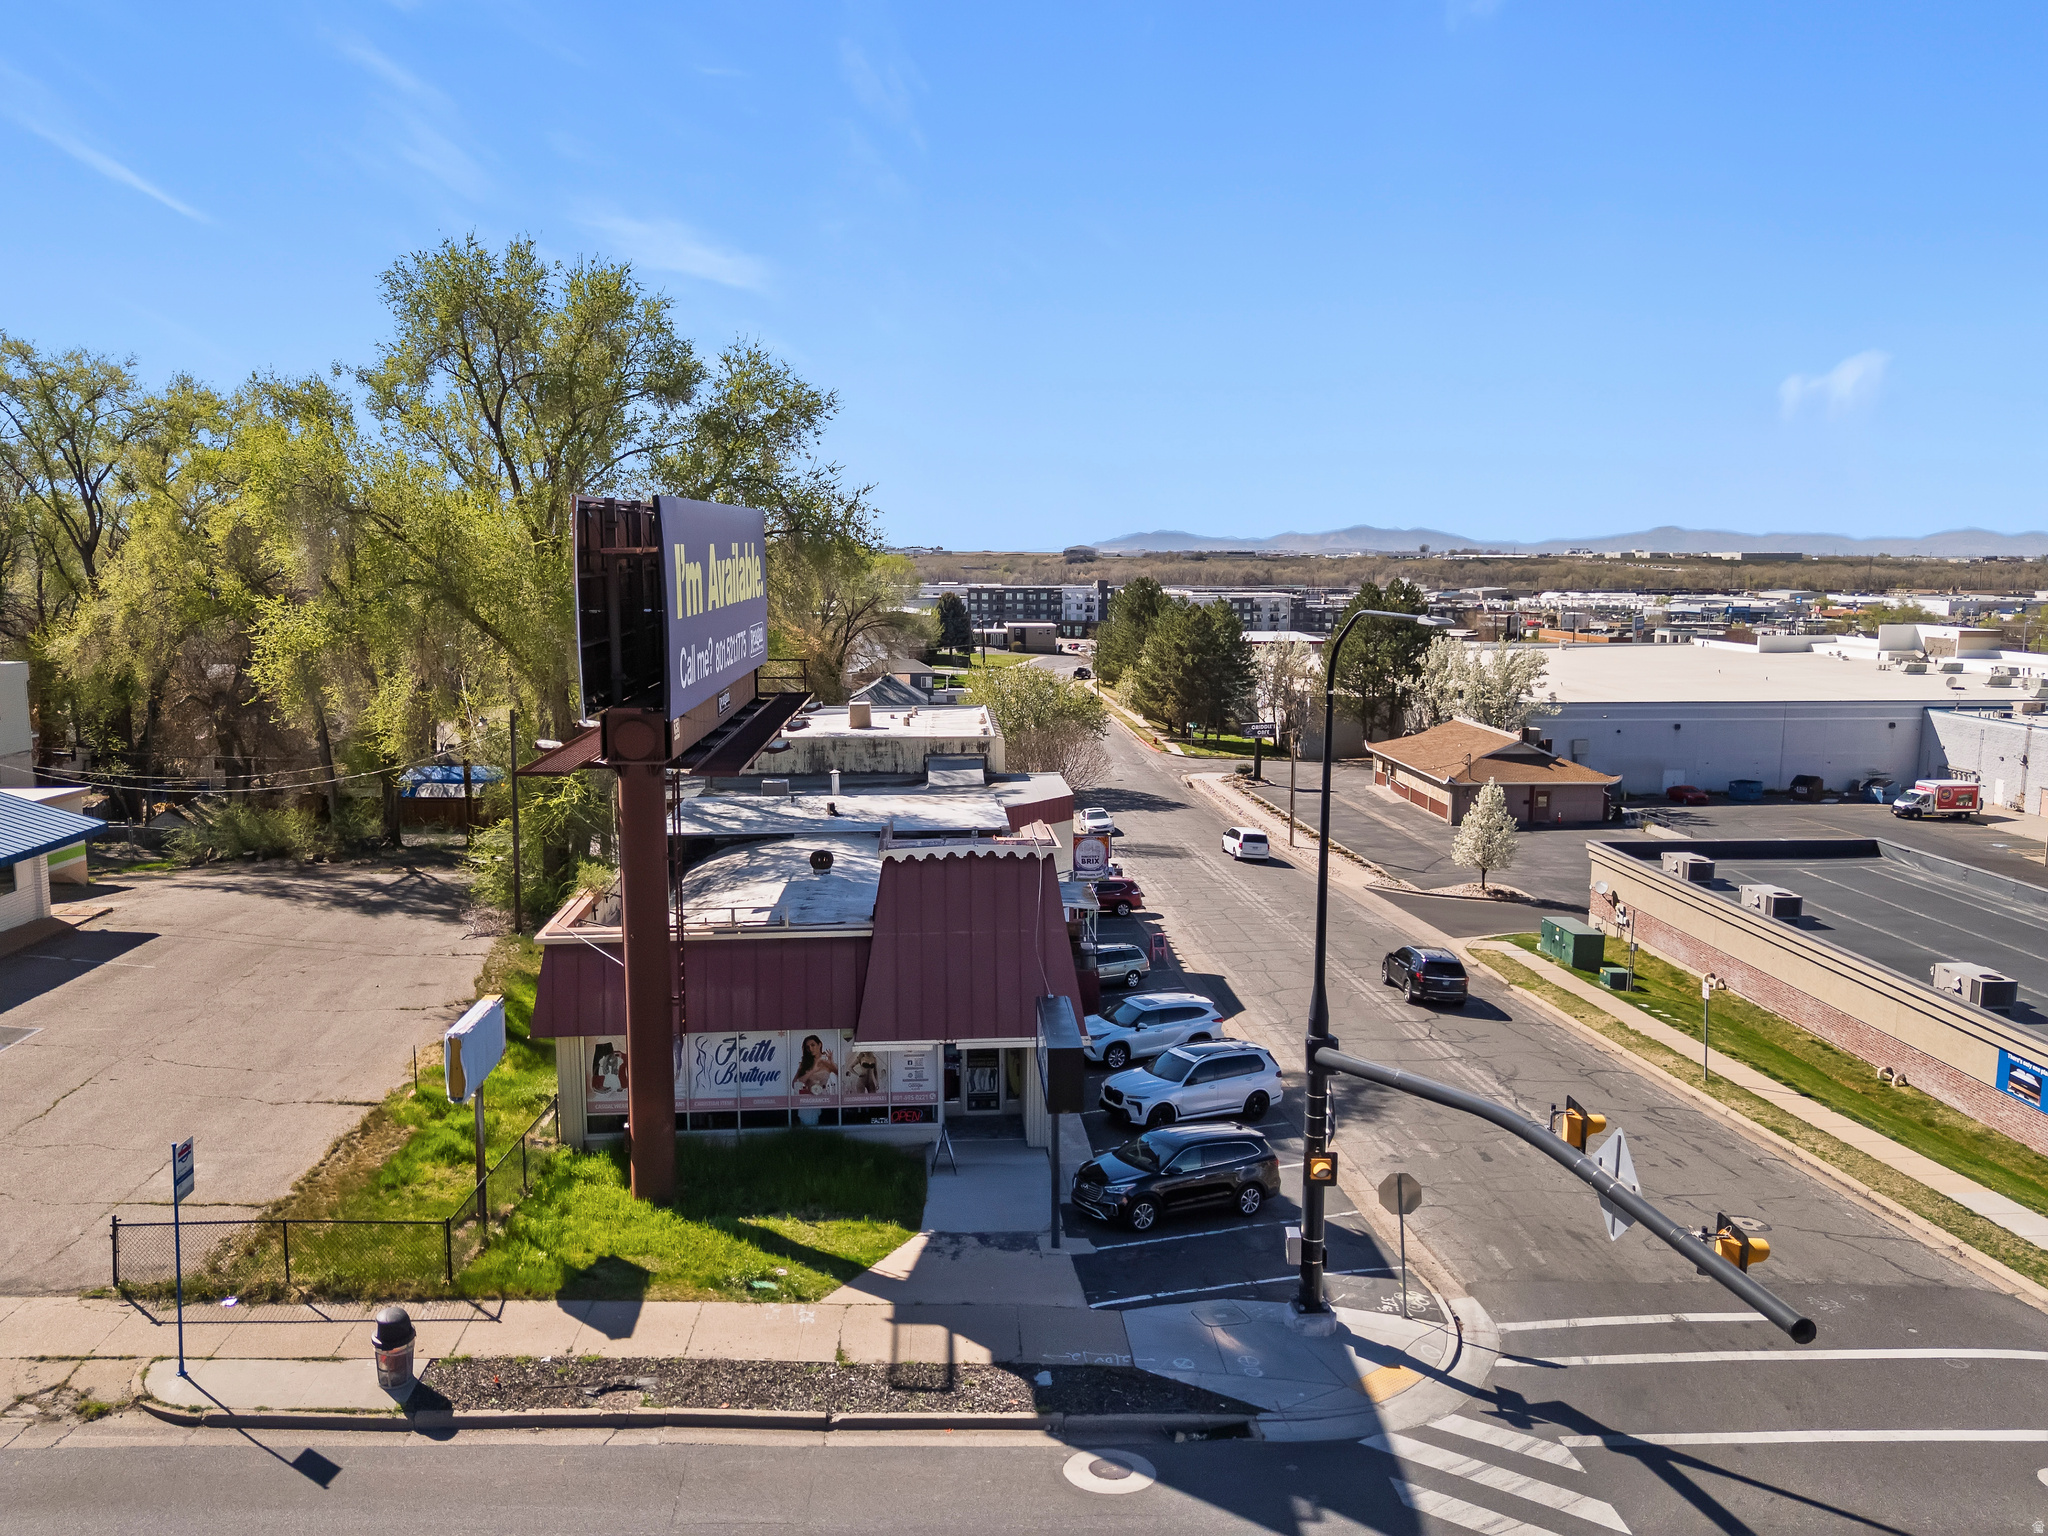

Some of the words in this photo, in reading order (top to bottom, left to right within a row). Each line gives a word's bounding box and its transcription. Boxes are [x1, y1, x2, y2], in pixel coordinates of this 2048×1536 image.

[674, 543, 703, 619] I'm
[707, 542, 764, 611] Available.
[680, 644, 697, 689] Call
[697, 637, 713, 680] me?
[715, 1033, 776, 1066] Faith
[714, 1062, 781, 1087] Boutique
[891, 1110, 921, 1122] OPEN
